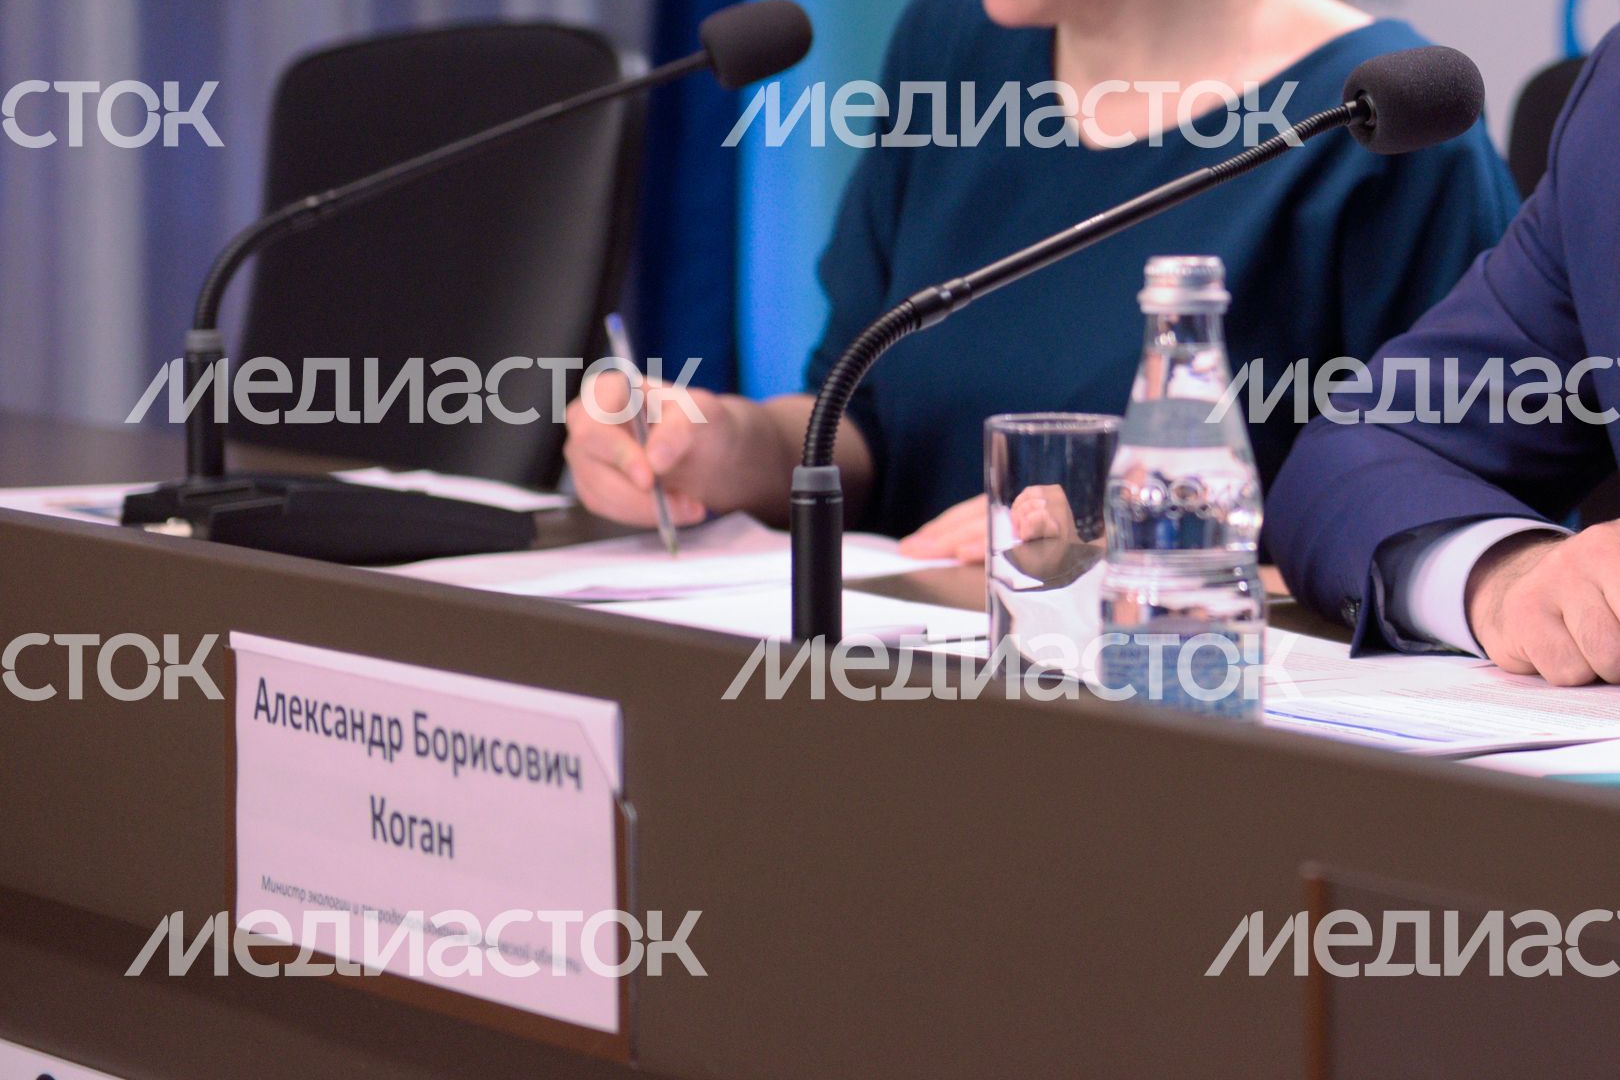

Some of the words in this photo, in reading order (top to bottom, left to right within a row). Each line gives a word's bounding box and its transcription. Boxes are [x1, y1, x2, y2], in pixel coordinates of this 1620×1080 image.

[254, 677, 403, 762] Александр
[413, 710, 584, 791] Борисович
[369, 794, 456, 859] Коган
[261, 875, 306, 904] Министр
